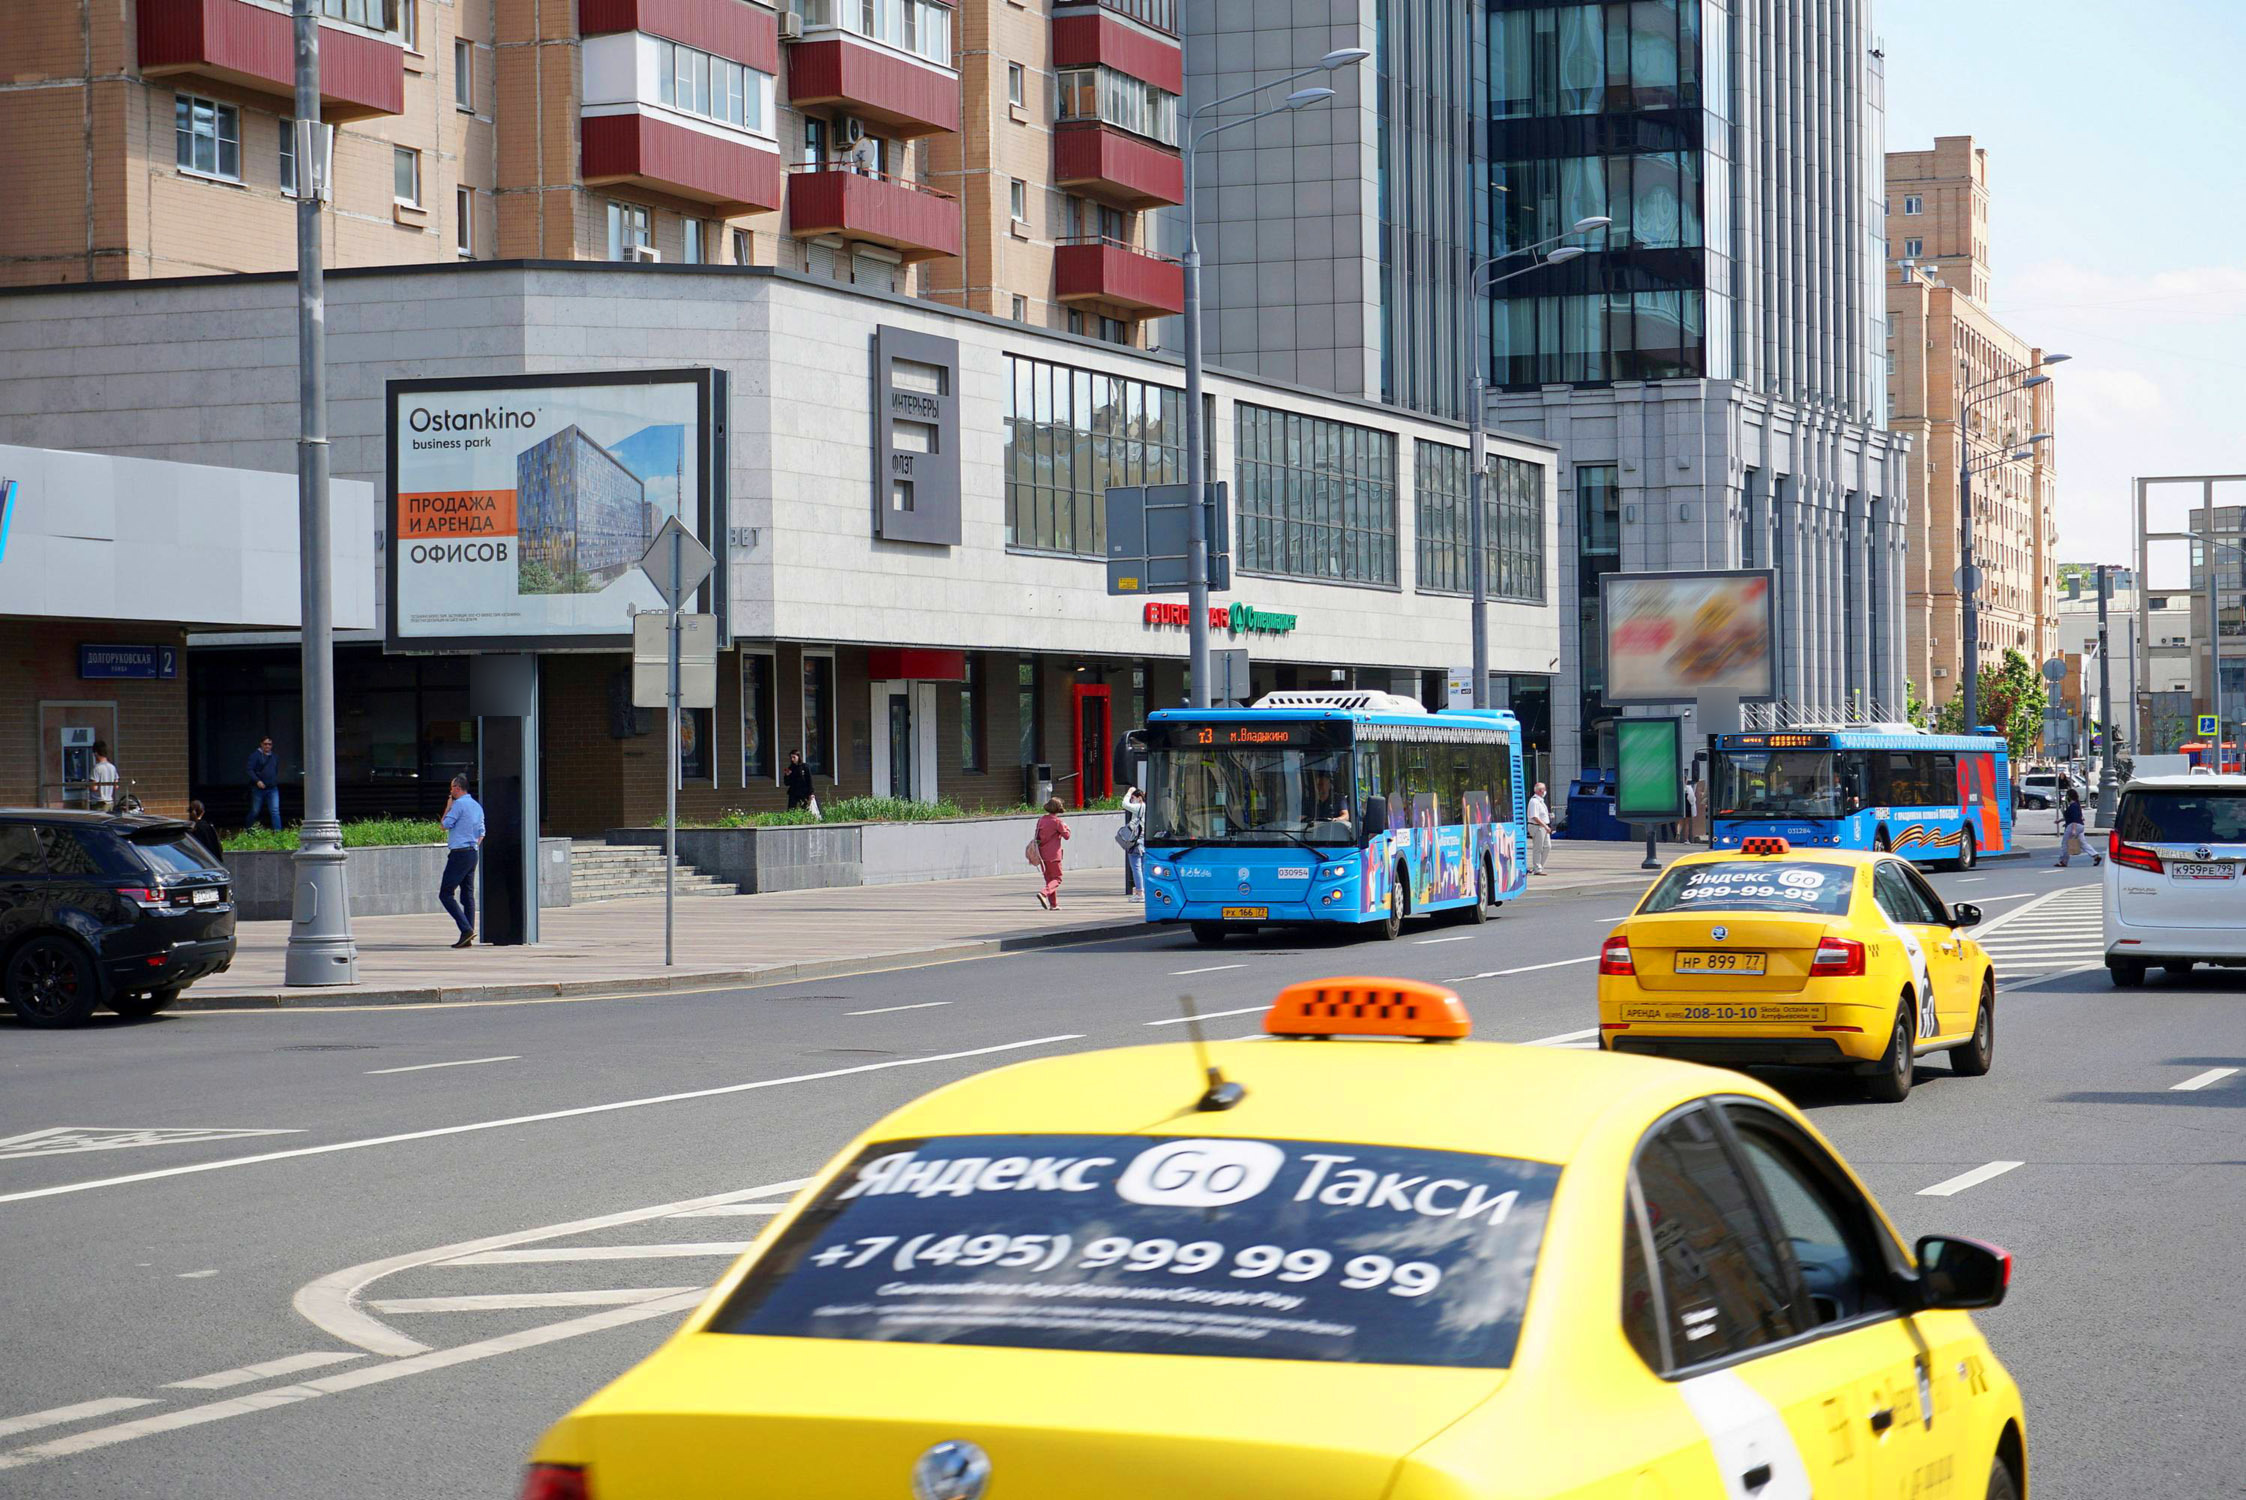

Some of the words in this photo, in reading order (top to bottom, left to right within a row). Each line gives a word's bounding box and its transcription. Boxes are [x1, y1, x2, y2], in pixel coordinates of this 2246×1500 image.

[892, 392, 940, 419] ИНТЕРЬЕРЫ
[412, 438, 461, 450] business
[465, 436, 491, 451] park
[892, 454, 914, 476] ФЛЭТ
[409, 496, 497, 514] ПРОДАЖА
[410, 518, 422, 533] И
[426, 516, 495, 533] АРЕНДА
[410, 543, 508, 564] ОФИСОВ
[1145, 602, 1229, 629] EUROAR
[1245, 605, 1298, 633] Супермаркет
[87, 652, 152, 665] ДОЛГОРУКОВСКАЯ
[163, 651, 173, 673] 2
[1787, 827, 1812, 835] 031284
[1278, 868, 1308, 877] 030954
[2175, 864, 2215, 875] К959РЕ
[2216, 864, 2232, 873] 799
[1686, 872, 1773, 886] Яндекс
[1679, 885, 1820, 902] 999-99-99
[1239, 908, 1254, 917] 166
[1682, 957, 1702, 969] НР
[1707, 954, 1737, 970] 899
[1745, 955, 1761, 966] 77
[1626, 1008, 1661, 1019] АРЕНДА
[1684, 1007, 1758, 1019] 208-10-10
[835, 1150, 1117, 1200] Яндекс
[1293, 1153, 1521, 1226] Такси
[812, 1235, 899, 1269] +7
[892, 1233, 1072, 1272] (495)
[1077, 1236, 1225, 1274] 999
[1229, 1244, 1333, 1283] 99
[1339, 1253, 1443, 1298] 99
